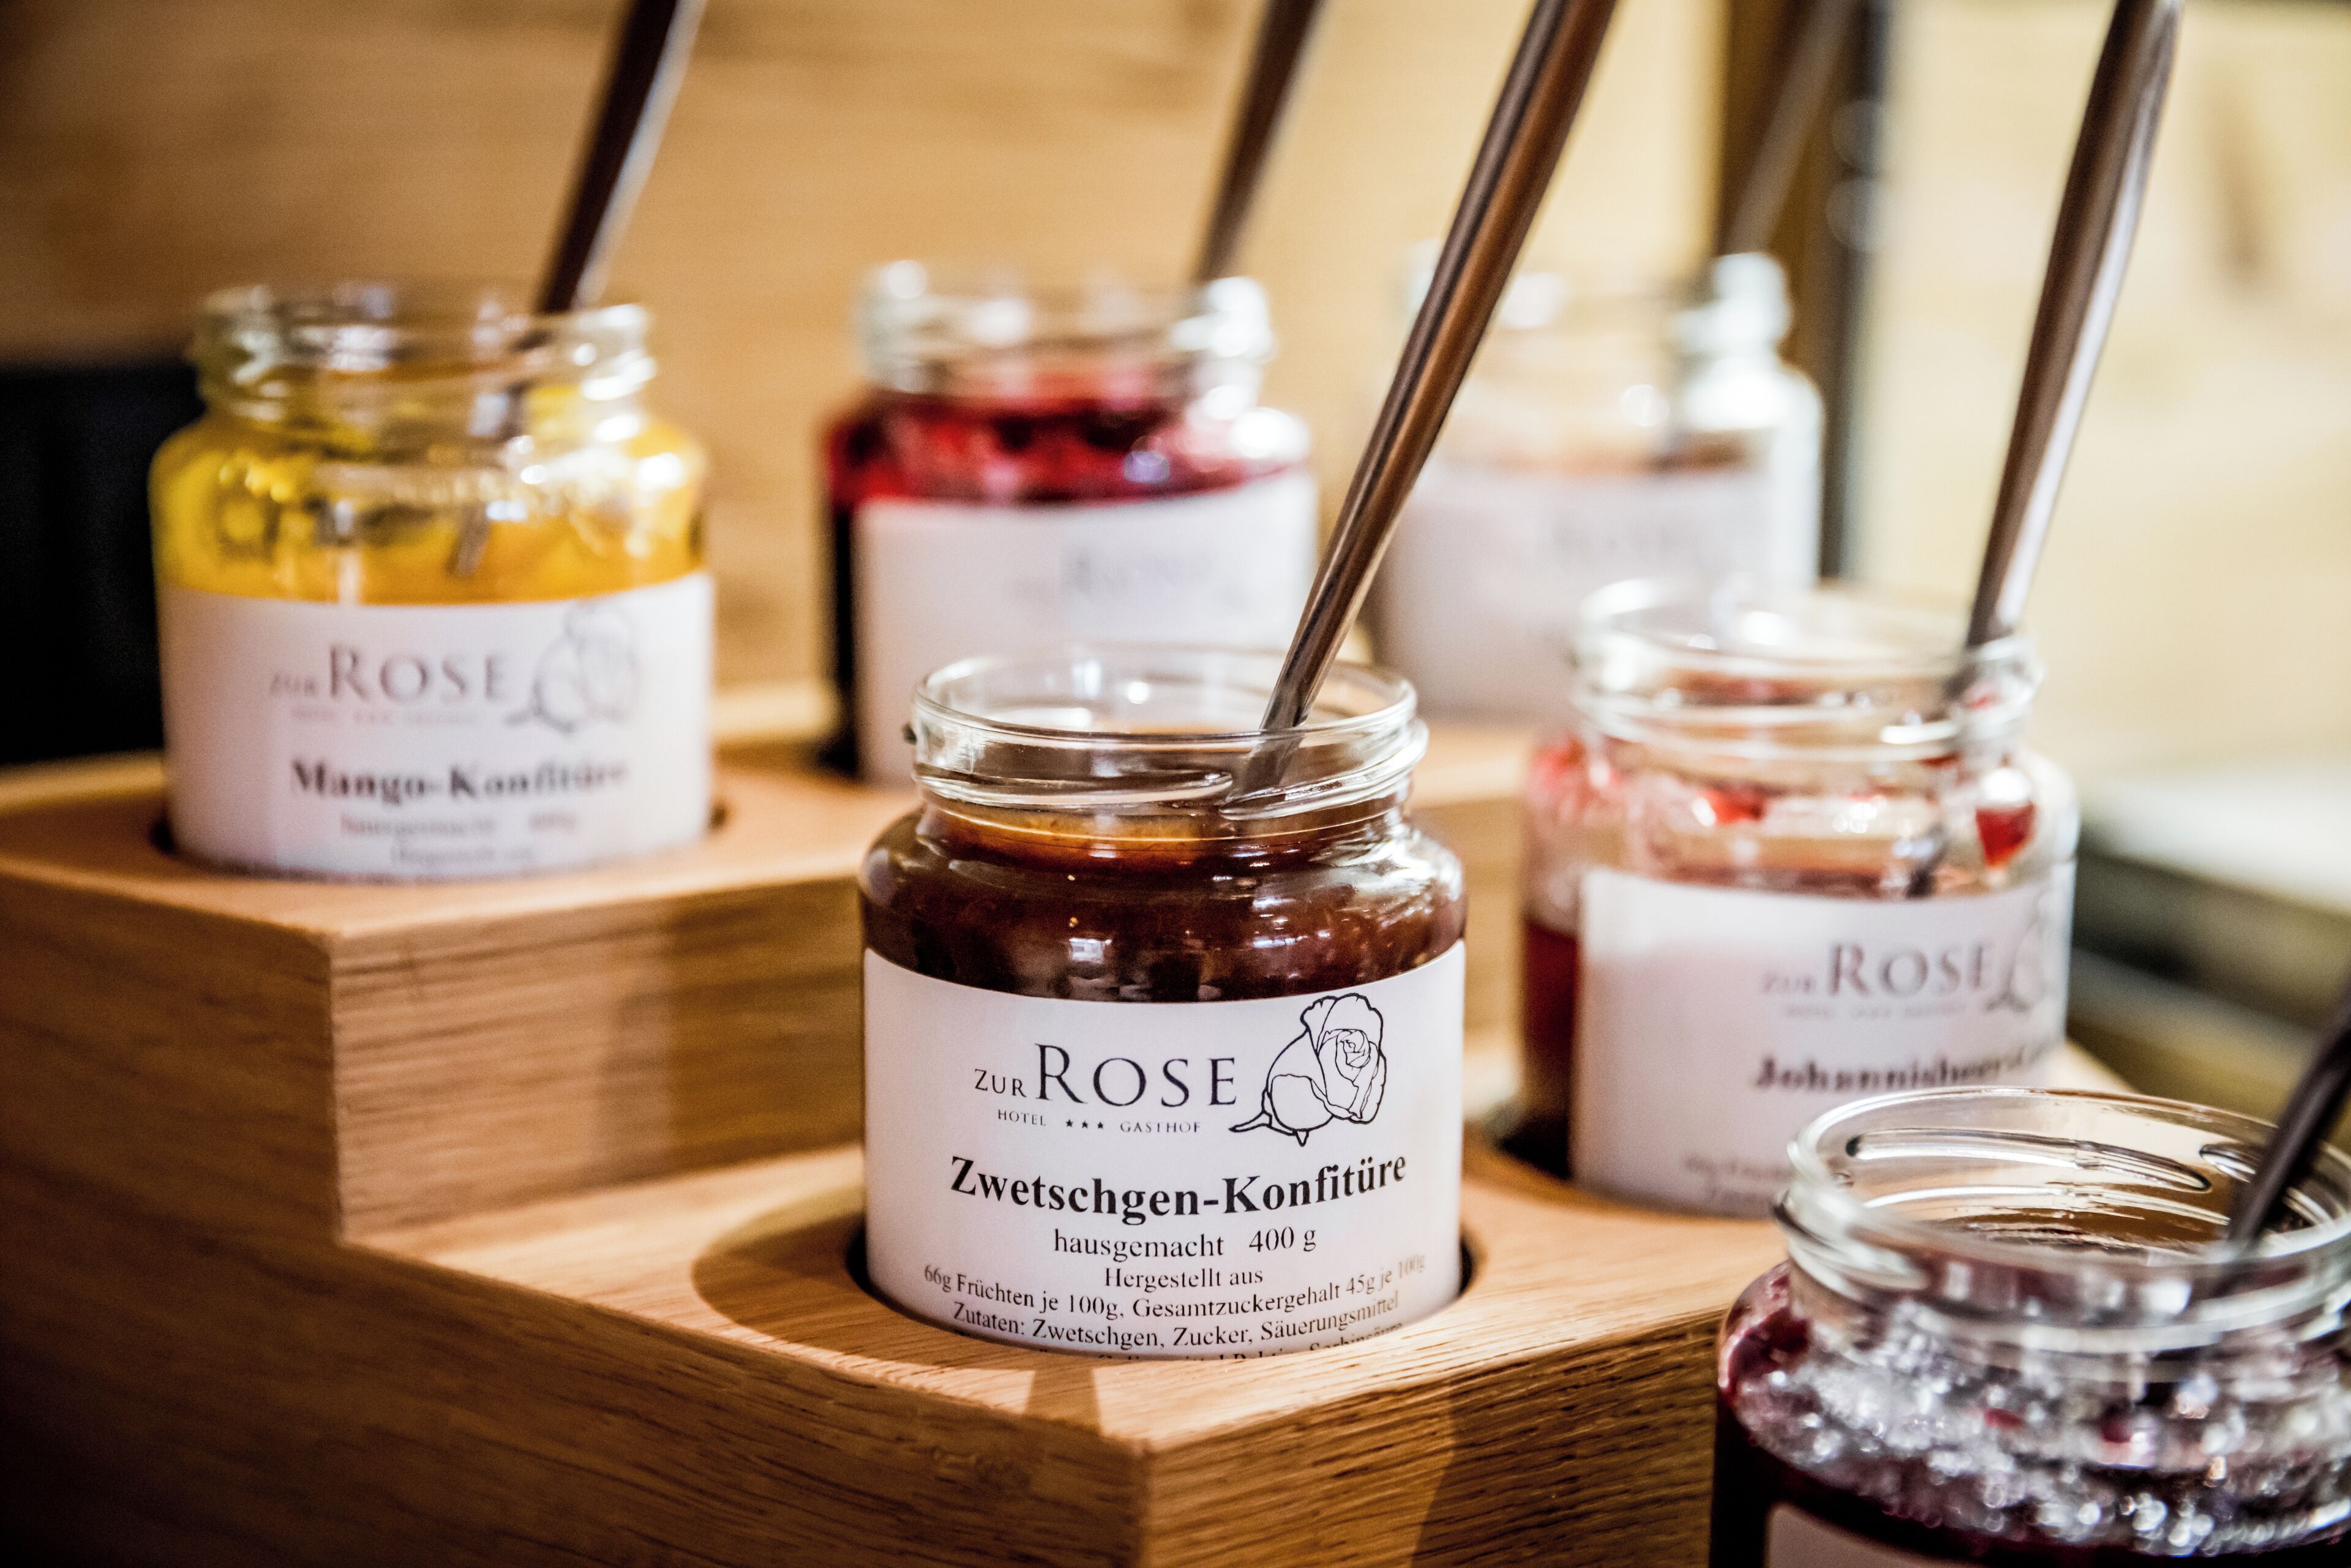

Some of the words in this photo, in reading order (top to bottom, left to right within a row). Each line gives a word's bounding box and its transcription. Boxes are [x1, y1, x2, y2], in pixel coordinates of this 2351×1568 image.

[1034, 1043, 1237, 1108] ROSE
[997, 1109, 1046, 1127] HOTEL
[1120, 1120, 1201, 1134] GASTHOF
[950, 1155, 1407, 1226] Zwetschgen-Konfitüre
[1054, 1229, 1224, 1263] hausgemacht
[1248, 1228, 1294, 1253] 400
[1303, 1229, 1318, 1251] g
[924, 1264, 951, 1293] 66g
[956, 1274, 1035, 1308] Früchten
[1038, 1291, 1059, 1314] je
[1070, 1294, 1124, 1321] 100g,
[1133, 1283, 1340, 1318] Gesamtzuckergehalt
[1346, 1274, 1375, 1295] 45g
[1379, 1267, 1393, 1291] je
[1398, 1253, 1426, 1278] 100g
[1104, 1267, 1221, 1293] Hergestellt
[1229, 1268, 1264, 1286] aus
[953, 1301, 1025, 1335] Zutaten:
[1033, 1319, 1166, 1351] Zwetschgen,
[1172, 1326, 1253, 1347] Zucker,
[1261, 1290, 1400, 1341] Säuerungsmittel
